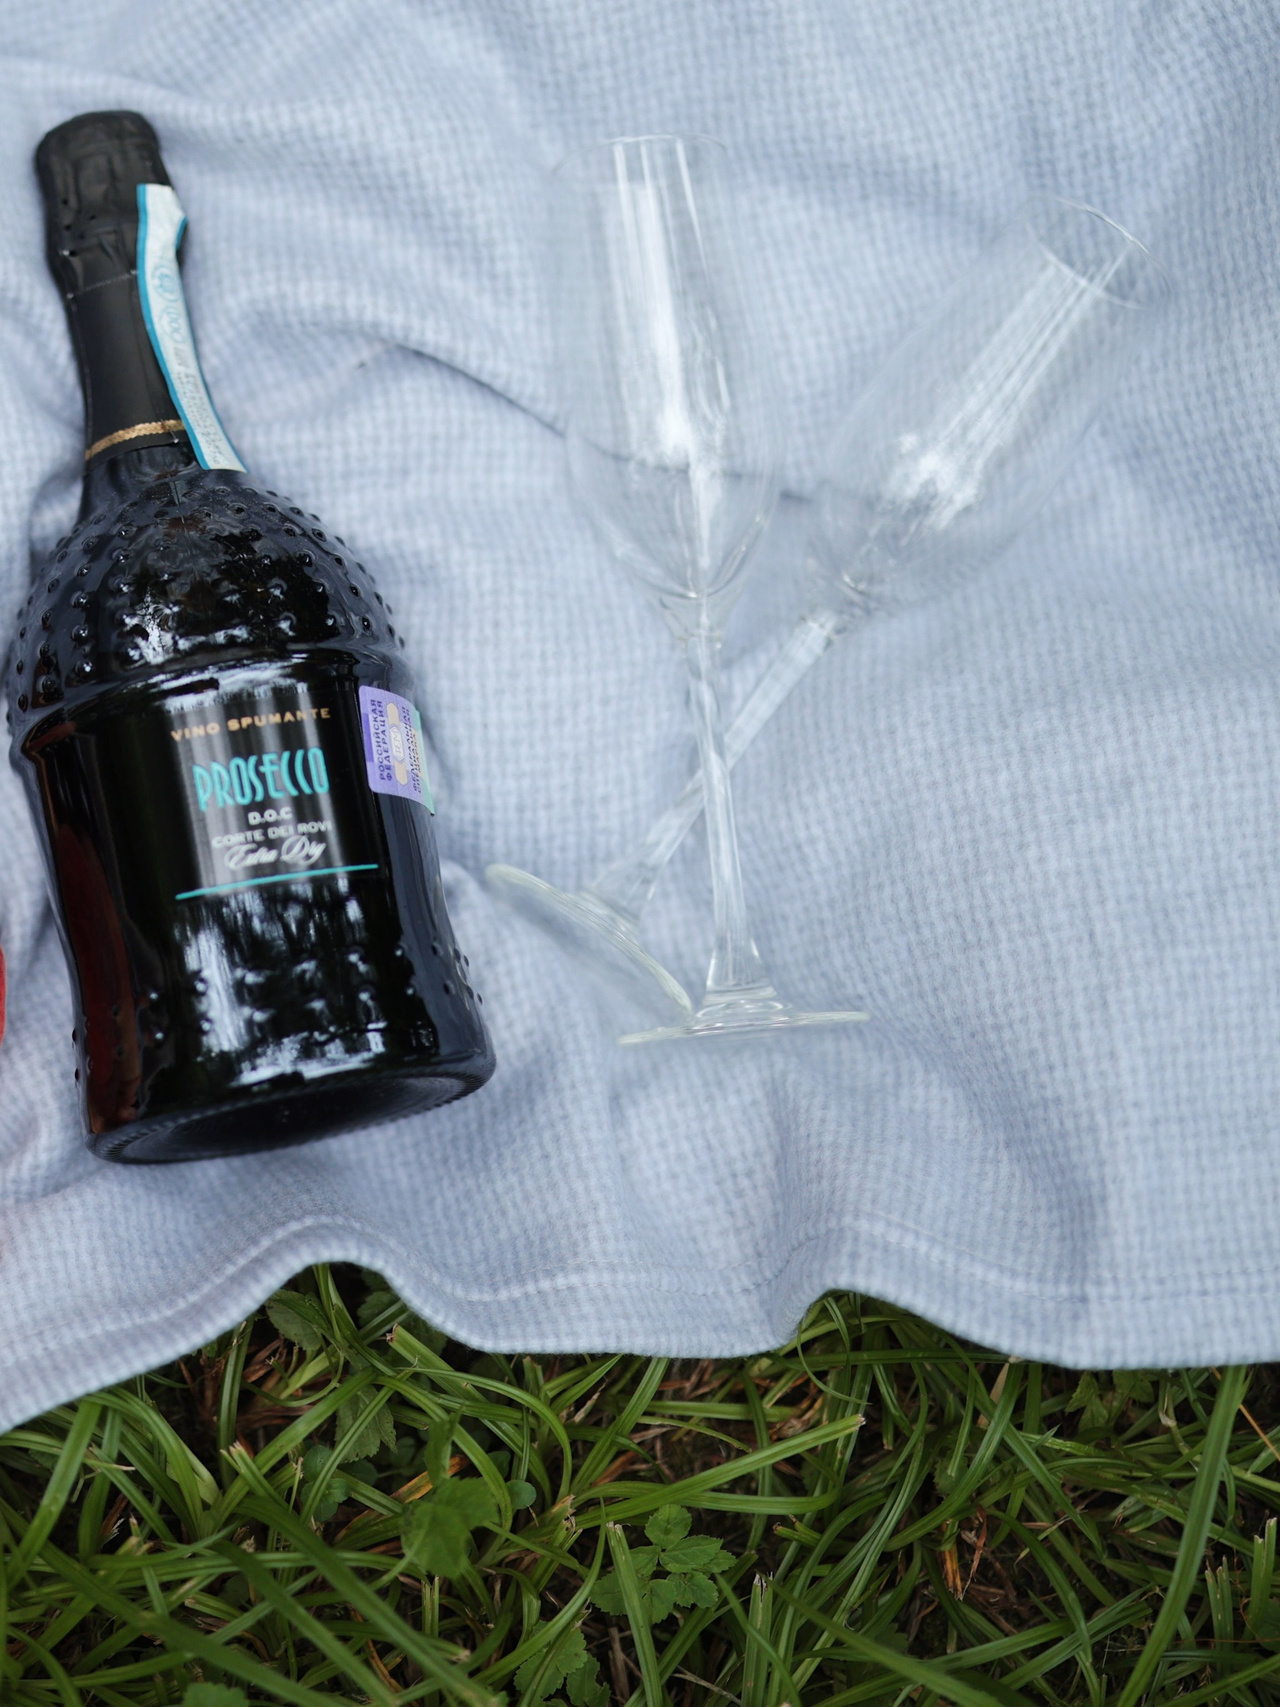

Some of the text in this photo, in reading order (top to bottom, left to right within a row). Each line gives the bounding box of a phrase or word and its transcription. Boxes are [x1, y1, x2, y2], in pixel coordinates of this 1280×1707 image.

[171, 708, 331, 742] VINO SPUMANTE
[370, 699, 387, 781] РОССИЙСКАЯ
[377, 700, 393, 782] ФЕДЕРАЦИЯ
[192, 747, 330, 811] PROSECCO
[212, 820, 332, 849] CORTE DEI ROVI
[224, 835, 326, 870] Extra Dry
